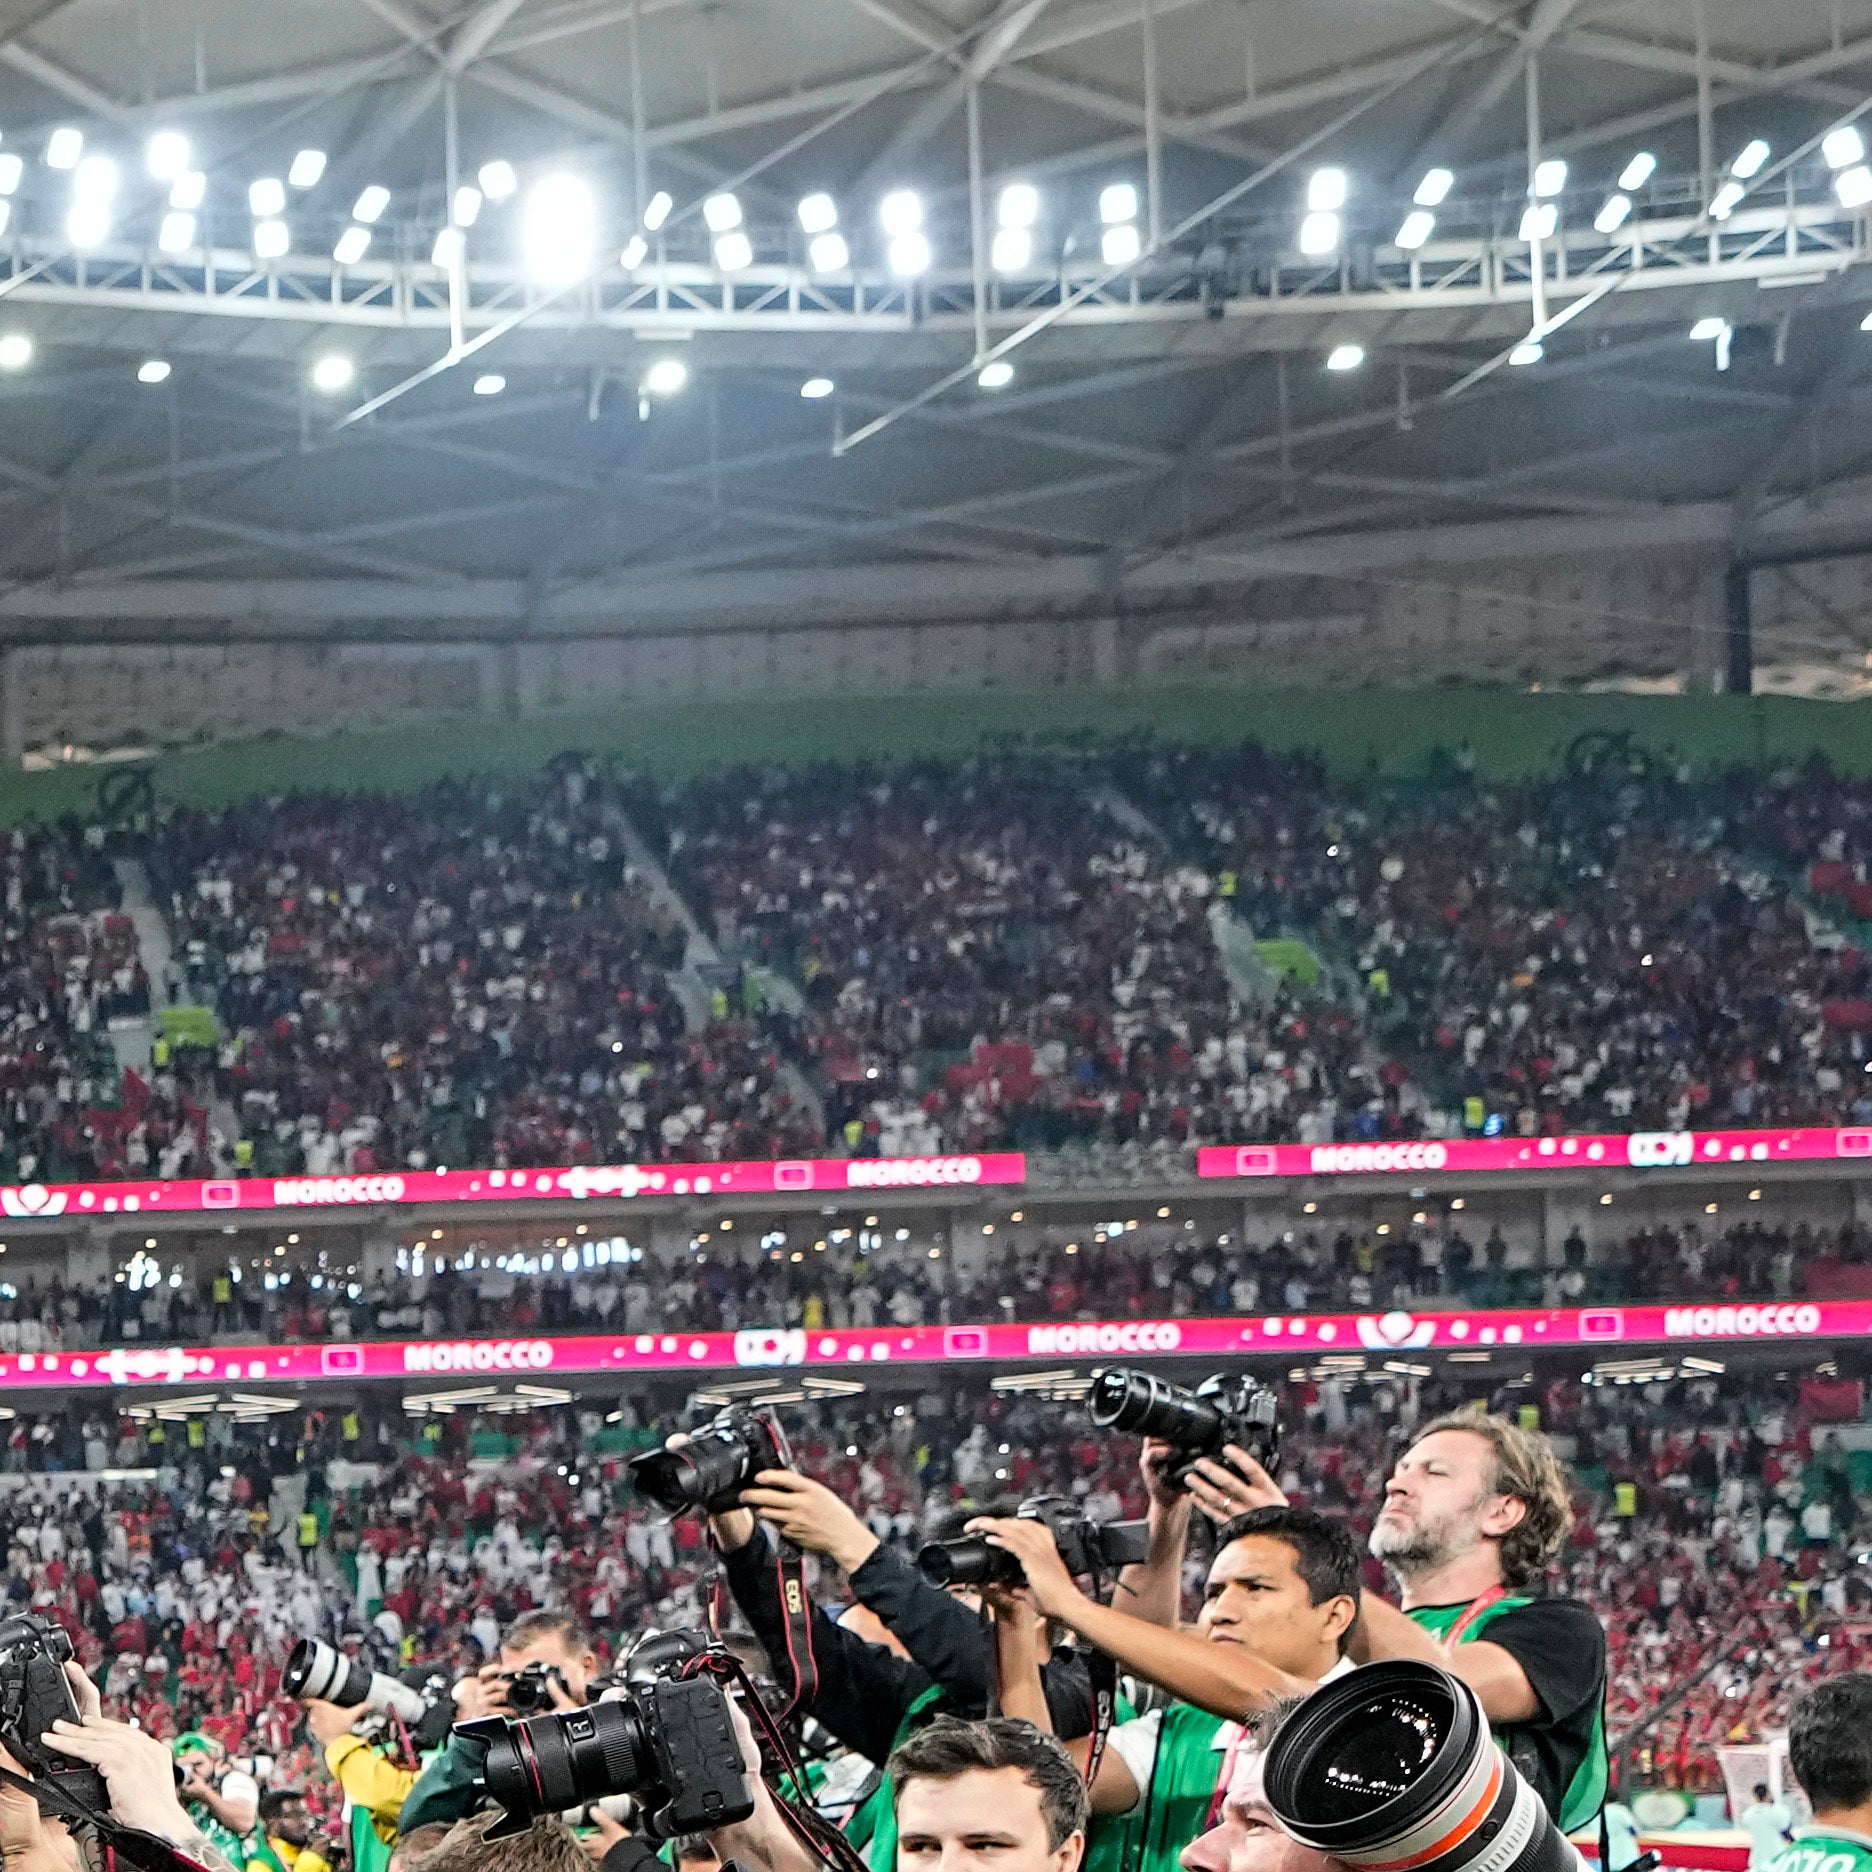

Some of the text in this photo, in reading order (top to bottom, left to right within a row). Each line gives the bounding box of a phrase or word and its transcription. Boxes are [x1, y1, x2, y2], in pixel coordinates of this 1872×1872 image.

[846, 1156, 982, 1188] MOROCCO
[1310, 1141, 1448, 1173] MOROCCO
[273, 1174, 405, 1205] MOROCCO
[1664, 1305, 1822, 1337] MOROCCO
[1028, 1322, 1181, 1354] MOROCCO
[404, 1340, 554, 1372] MOROCCO
